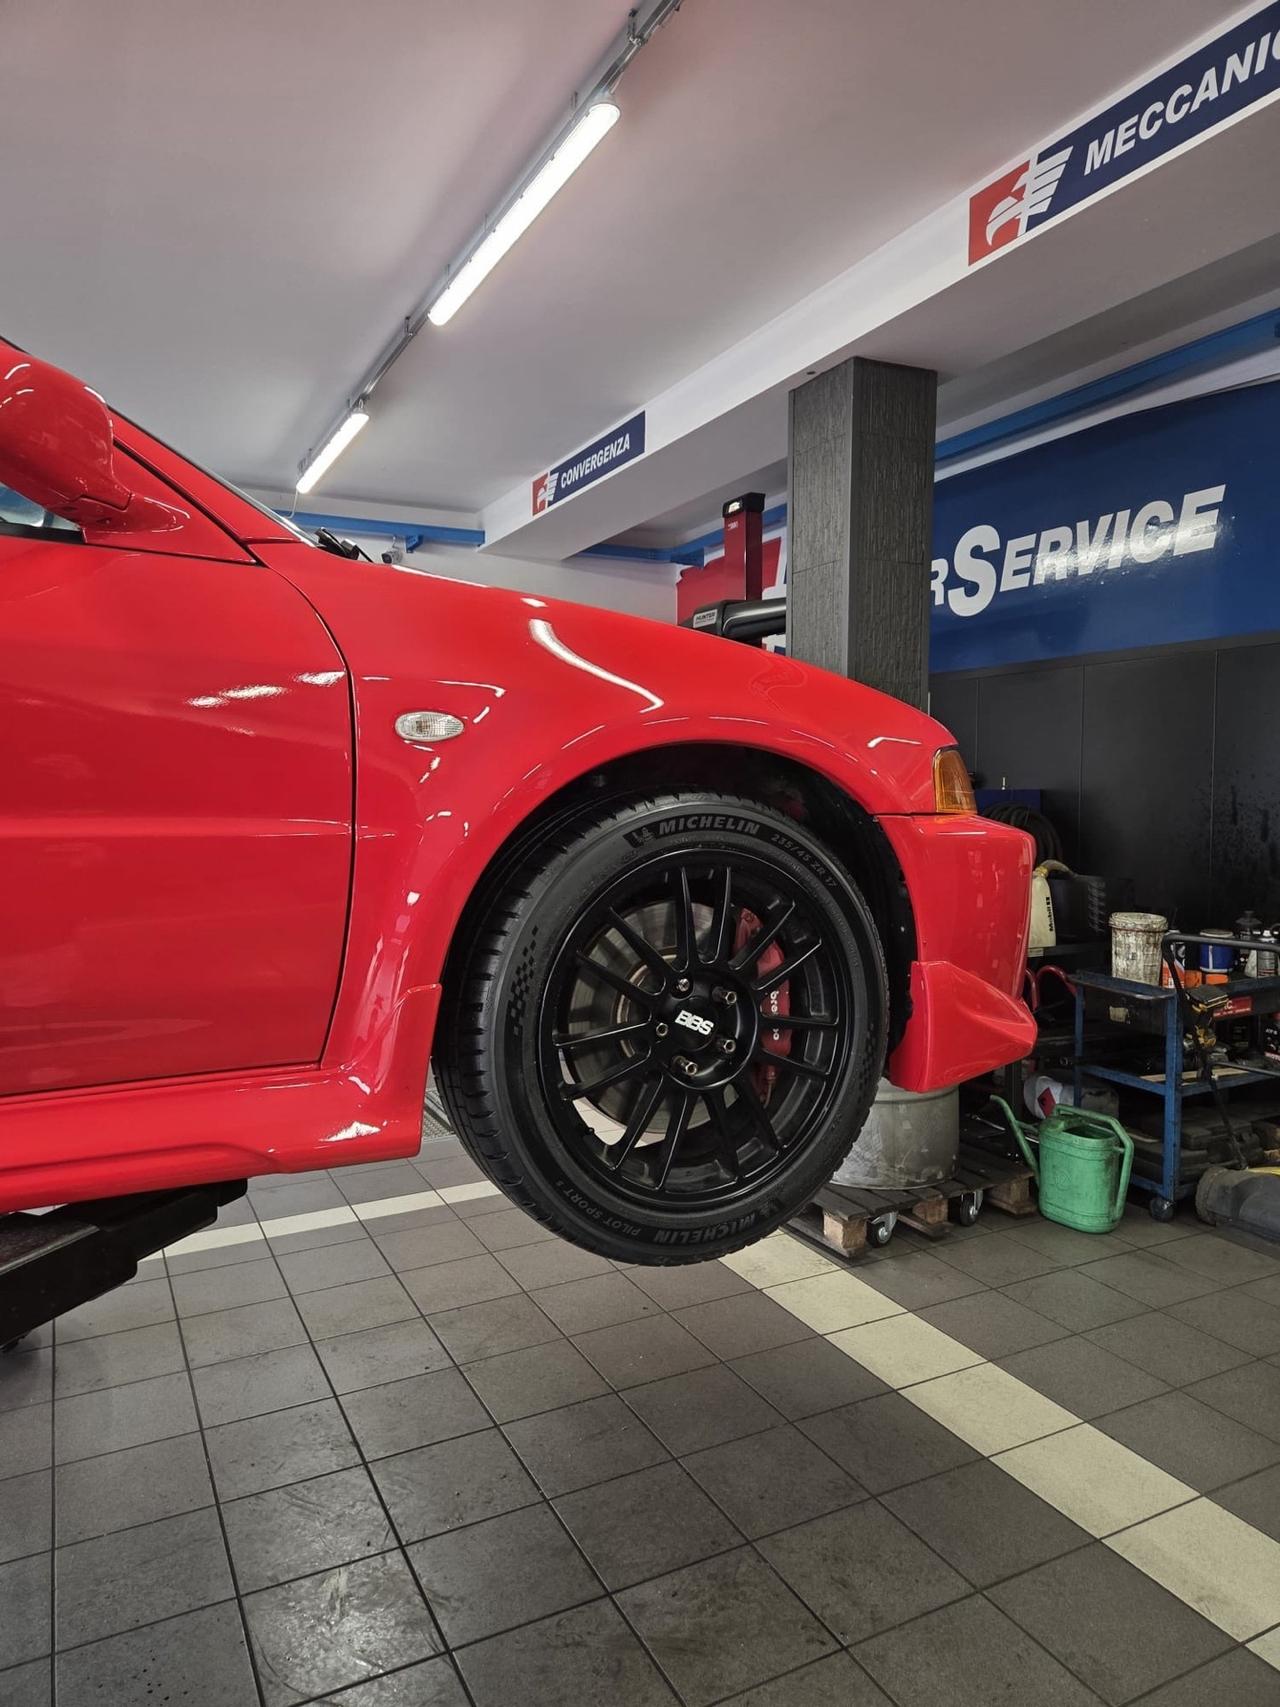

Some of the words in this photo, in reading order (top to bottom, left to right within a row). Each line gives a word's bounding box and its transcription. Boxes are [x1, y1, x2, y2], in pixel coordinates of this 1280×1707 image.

[561, 433, 630, 488] CONVERGENZA
[659, 815, 760, 836] MICHELIN
[771, 833, 811, 861] 235/45
[674, 1009, 715, 1036] BBS
[563, 1188, 604, 1219] SPORT
[602, 1217, 642, 1236] PILOT
[653, 1213, 756, 1244] MICHELIN
